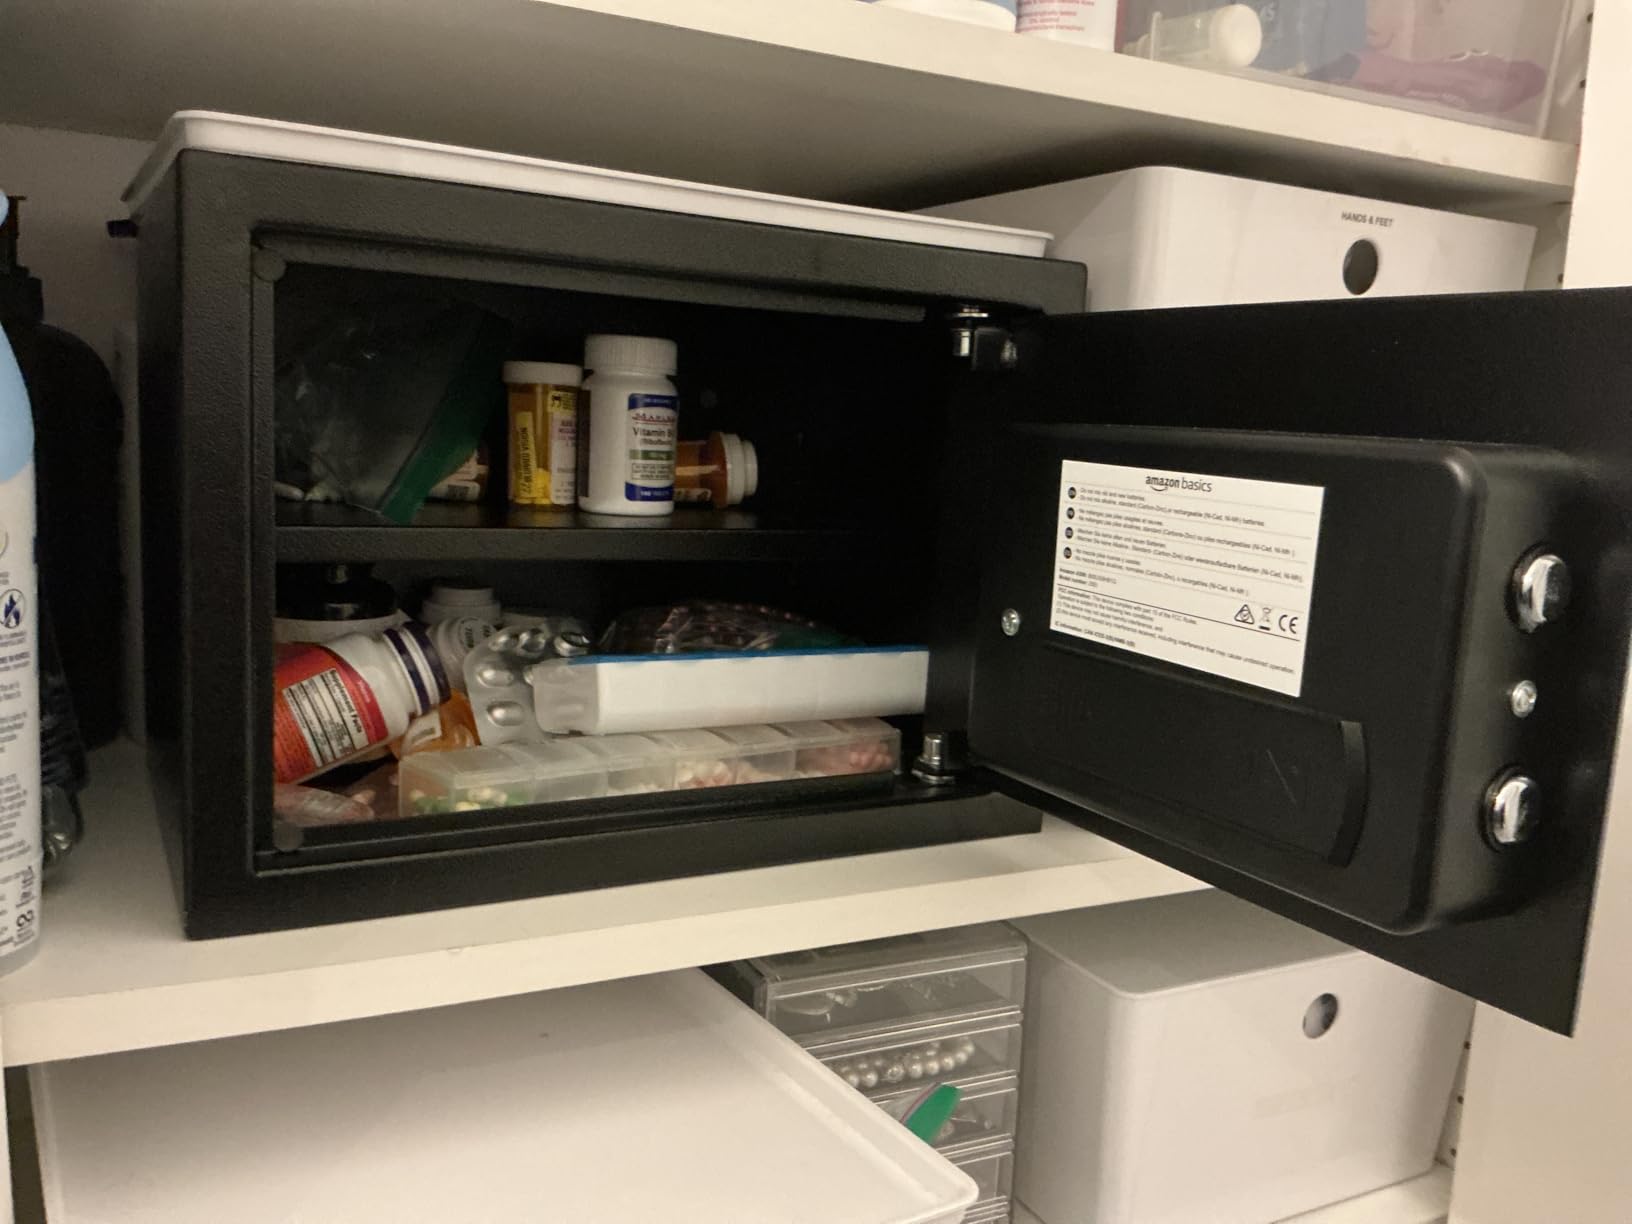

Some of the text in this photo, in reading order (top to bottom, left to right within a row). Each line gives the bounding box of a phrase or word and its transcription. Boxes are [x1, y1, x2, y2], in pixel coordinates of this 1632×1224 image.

[1341, 211, 1393, 227] HANDS & FEET
[1145, 475, 1213, 493] amazon basics
